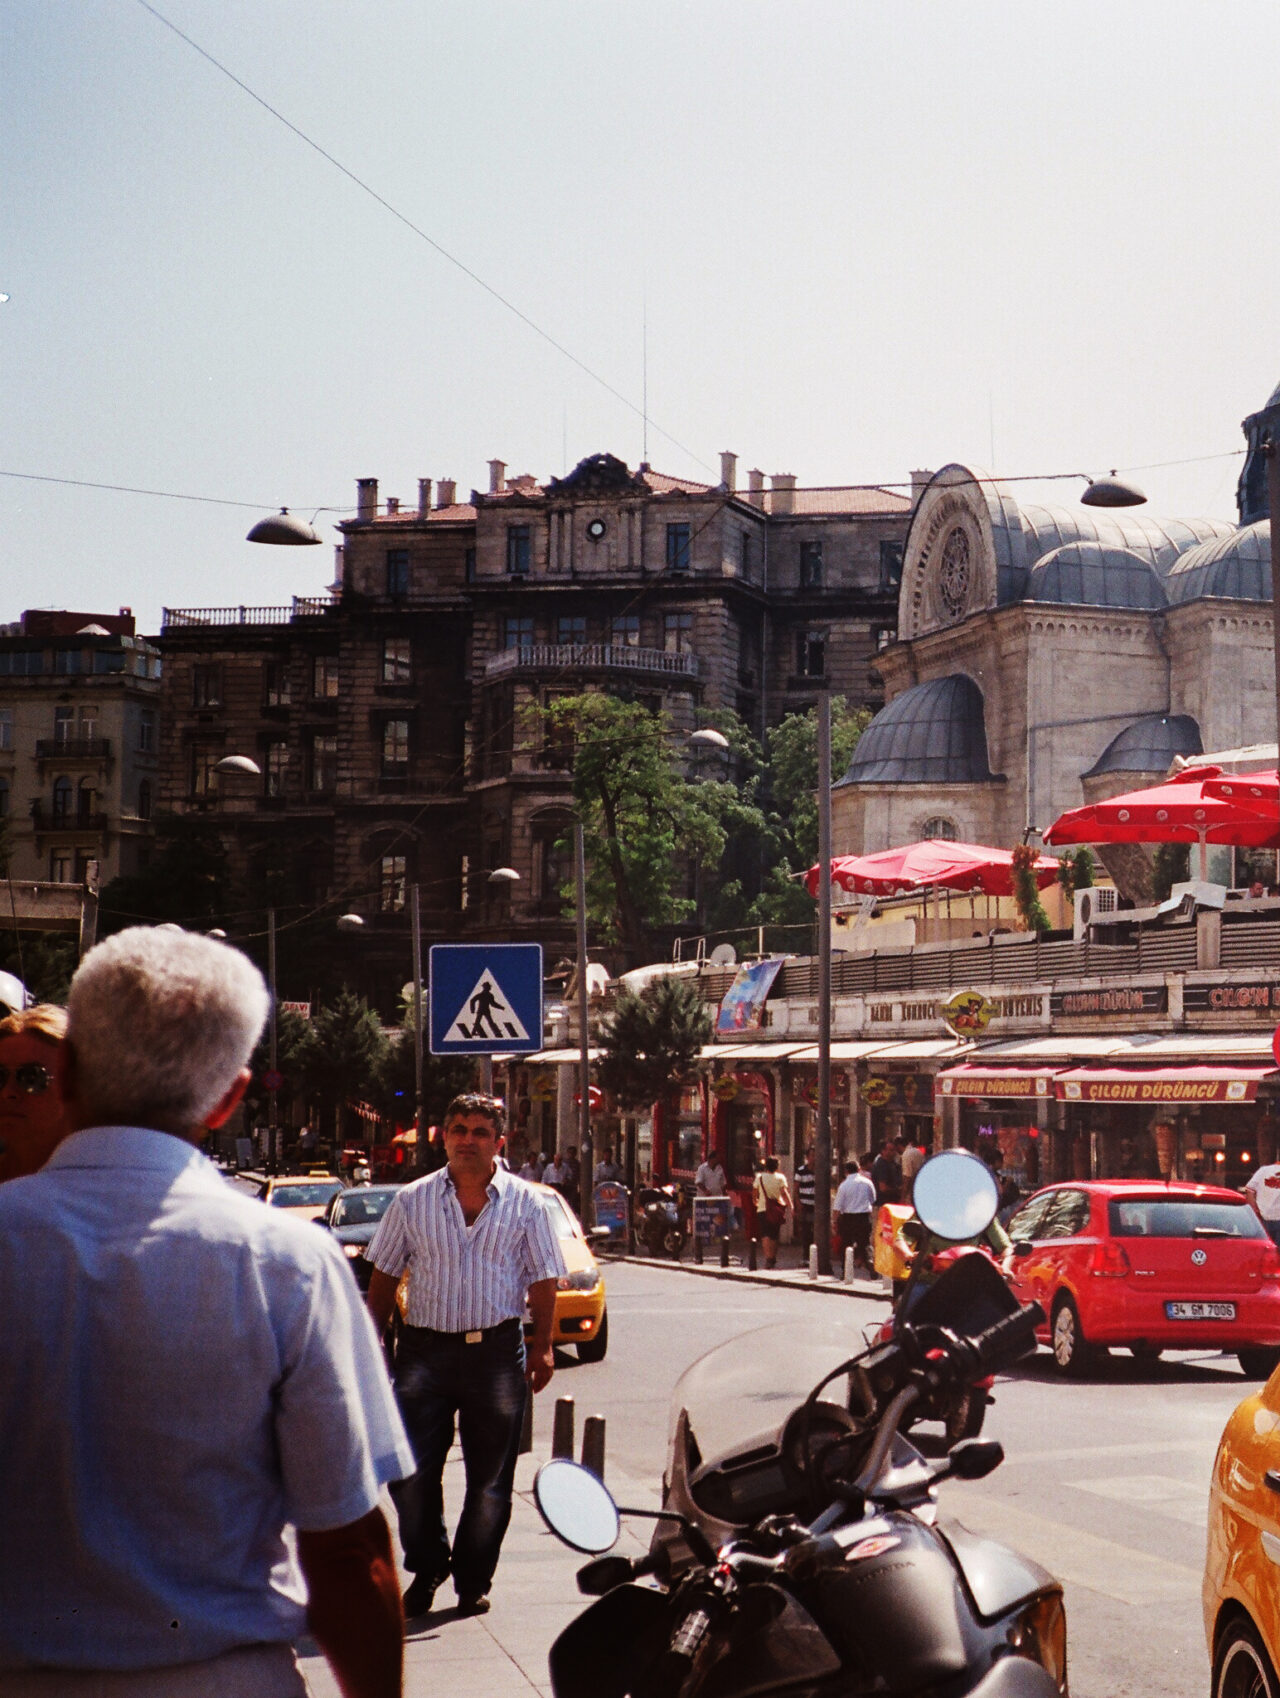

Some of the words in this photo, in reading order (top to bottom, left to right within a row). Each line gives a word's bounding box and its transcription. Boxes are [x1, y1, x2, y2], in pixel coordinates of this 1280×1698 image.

[1089, 1083, 1138, 1101] ÇILGIN
[1141, 1080, 1219, 1099] DÜRÜMCÜ
[1173, 1304, 1186, 1315] 34
